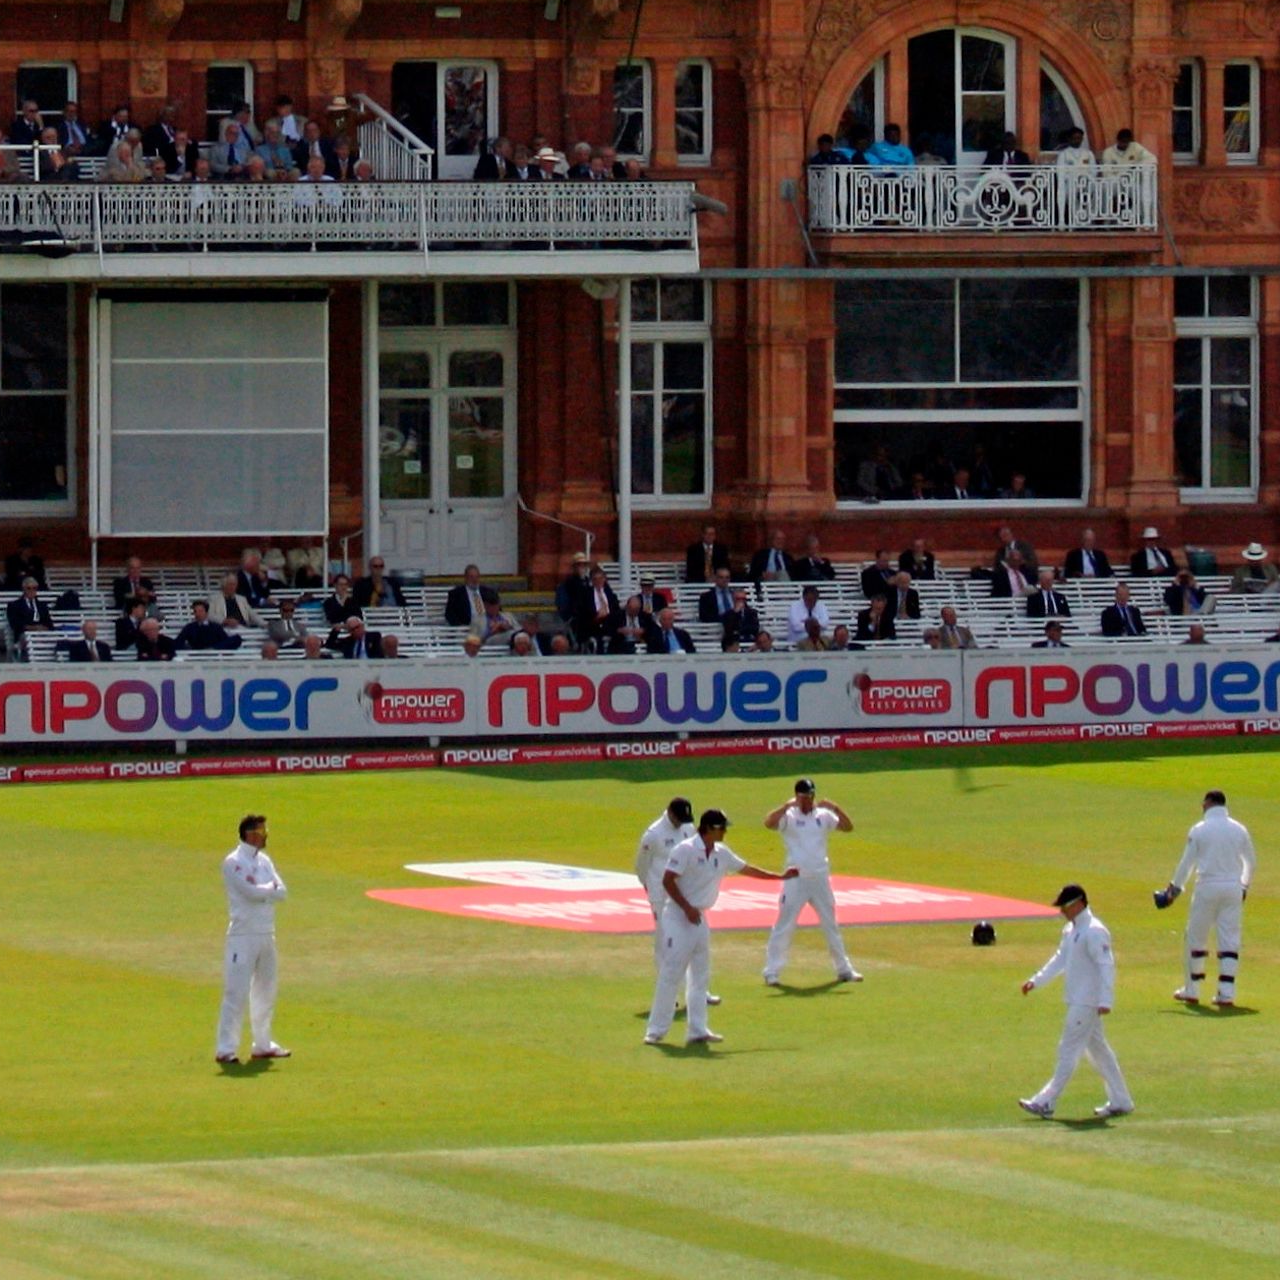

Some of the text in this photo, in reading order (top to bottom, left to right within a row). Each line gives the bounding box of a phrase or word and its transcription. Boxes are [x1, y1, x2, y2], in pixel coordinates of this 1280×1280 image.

[487, 669, 828, 727] npower
[869, 685, 943, 699] npower
[381, 694, 456, 708] npower
[870, 700, 943, 709] TEST SERIES
[382, 709, 456, 718] TEST SERIES
[109, 761, 187, 776] npower
[276, 755, 353, 770] npower
[444, 748, 519, 763] npower
[606, 741, 681, 756] npower
[768, 735, 841, 750] npower
[924, 728, 996, 744] npower
[1080, 723, 1153, 738] npower
